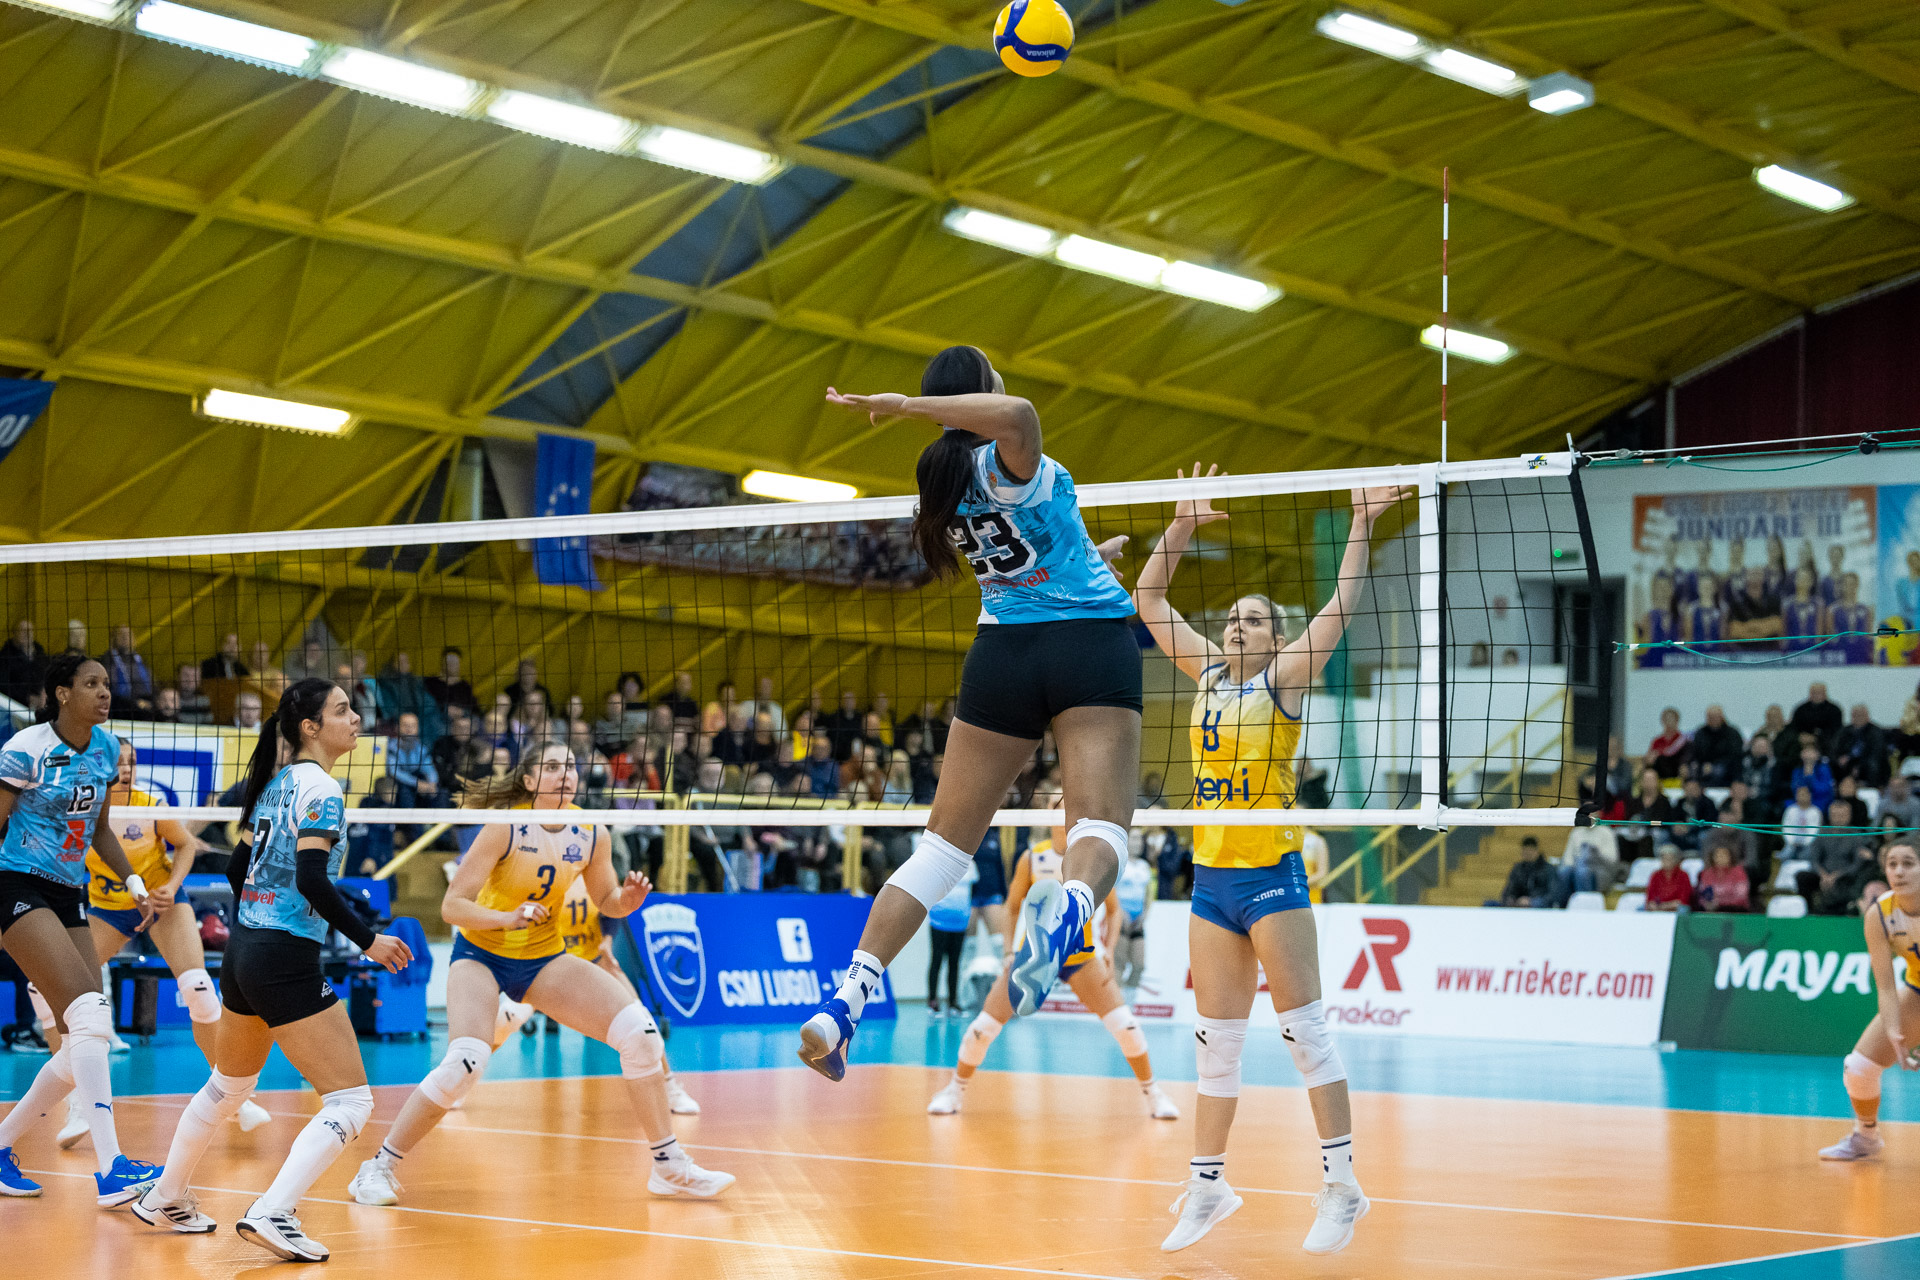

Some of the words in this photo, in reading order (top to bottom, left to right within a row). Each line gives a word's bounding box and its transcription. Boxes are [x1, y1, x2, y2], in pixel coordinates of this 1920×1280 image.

[949, 511, 1037, 578] 23
[66, 784, 97, 815] 12
[527, 864, 557, 901] 3
[566, 898, 588, 926] 11
[848, 960, 862, 981] nine
[1436, 959, 1655, 999] www.rieker.com
[718, 969, 765, 1008] CSM
[762, 969, 822, 1006] LUGOJ
[1325, 1000, 1412, 1026] rieker
